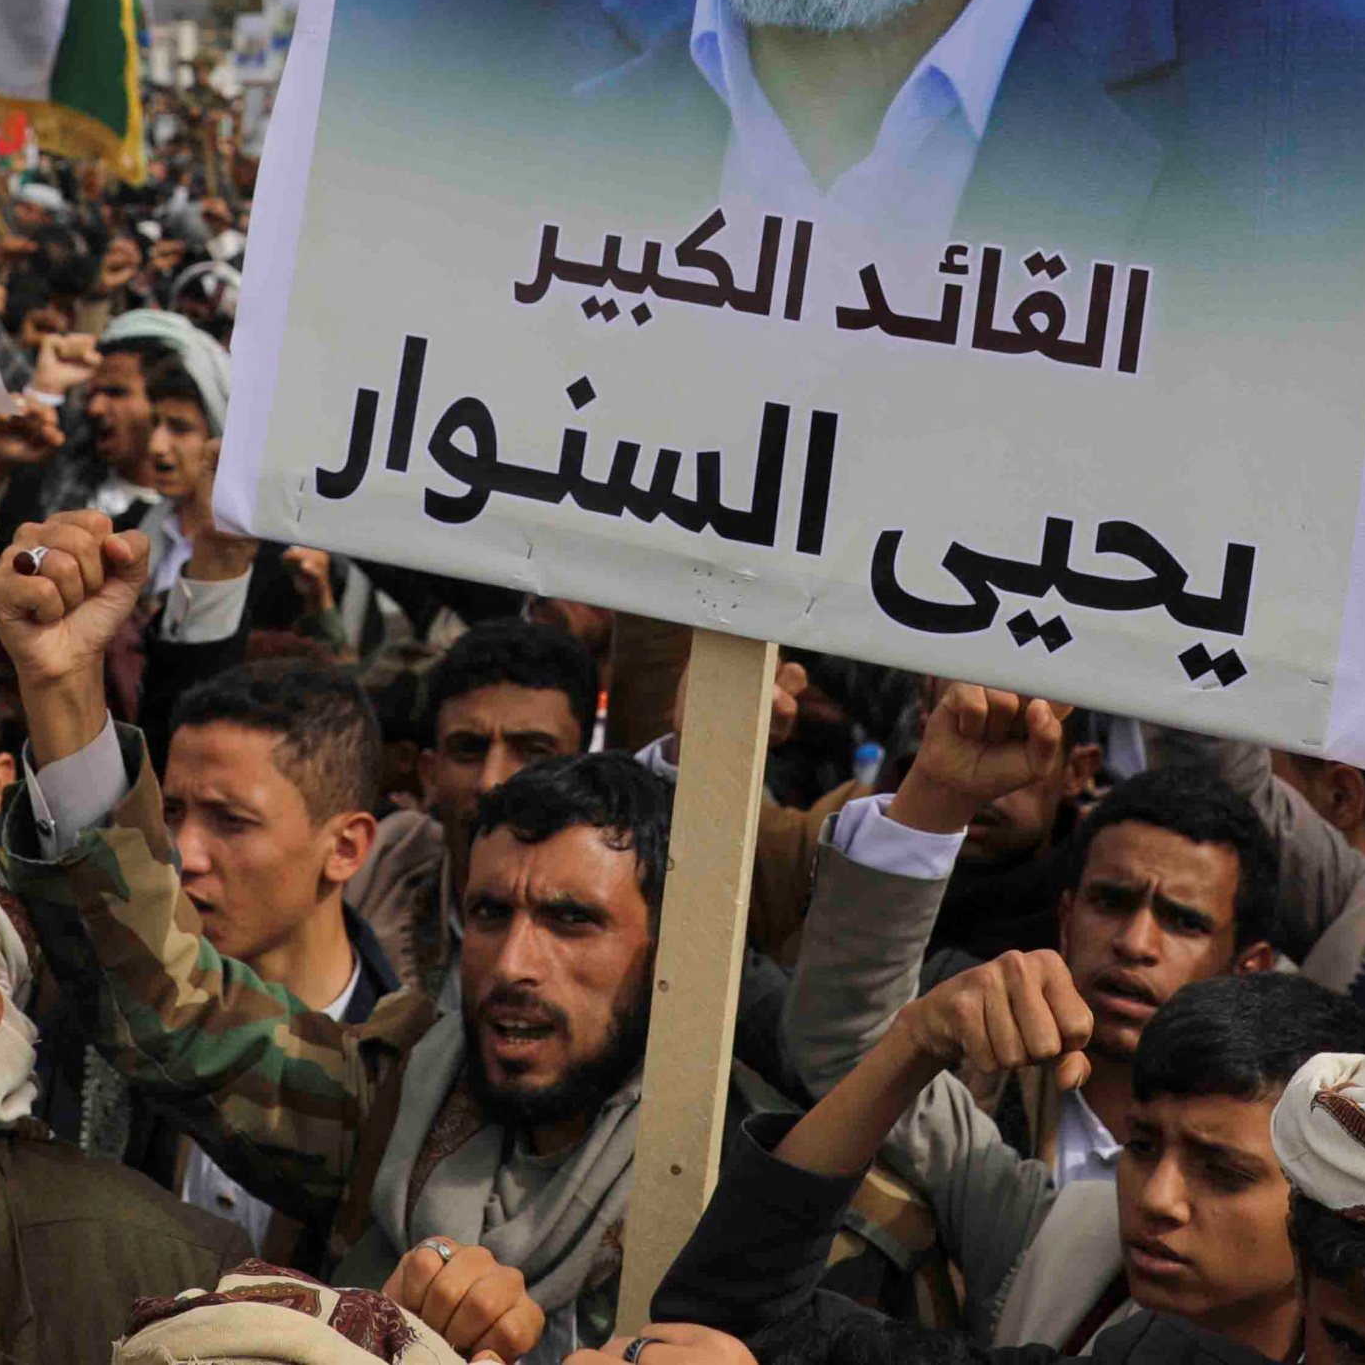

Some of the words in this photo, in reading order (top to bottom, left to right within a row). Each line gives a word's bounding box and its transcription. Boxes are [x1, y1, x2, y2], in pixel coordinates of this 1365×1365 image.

[514, 207, 814, 329] الكبير
[835, 239, 1151, 376] القائد
[316, 333, 840, 556] السنوار
[870, 510, 1258, 689] يحيى
